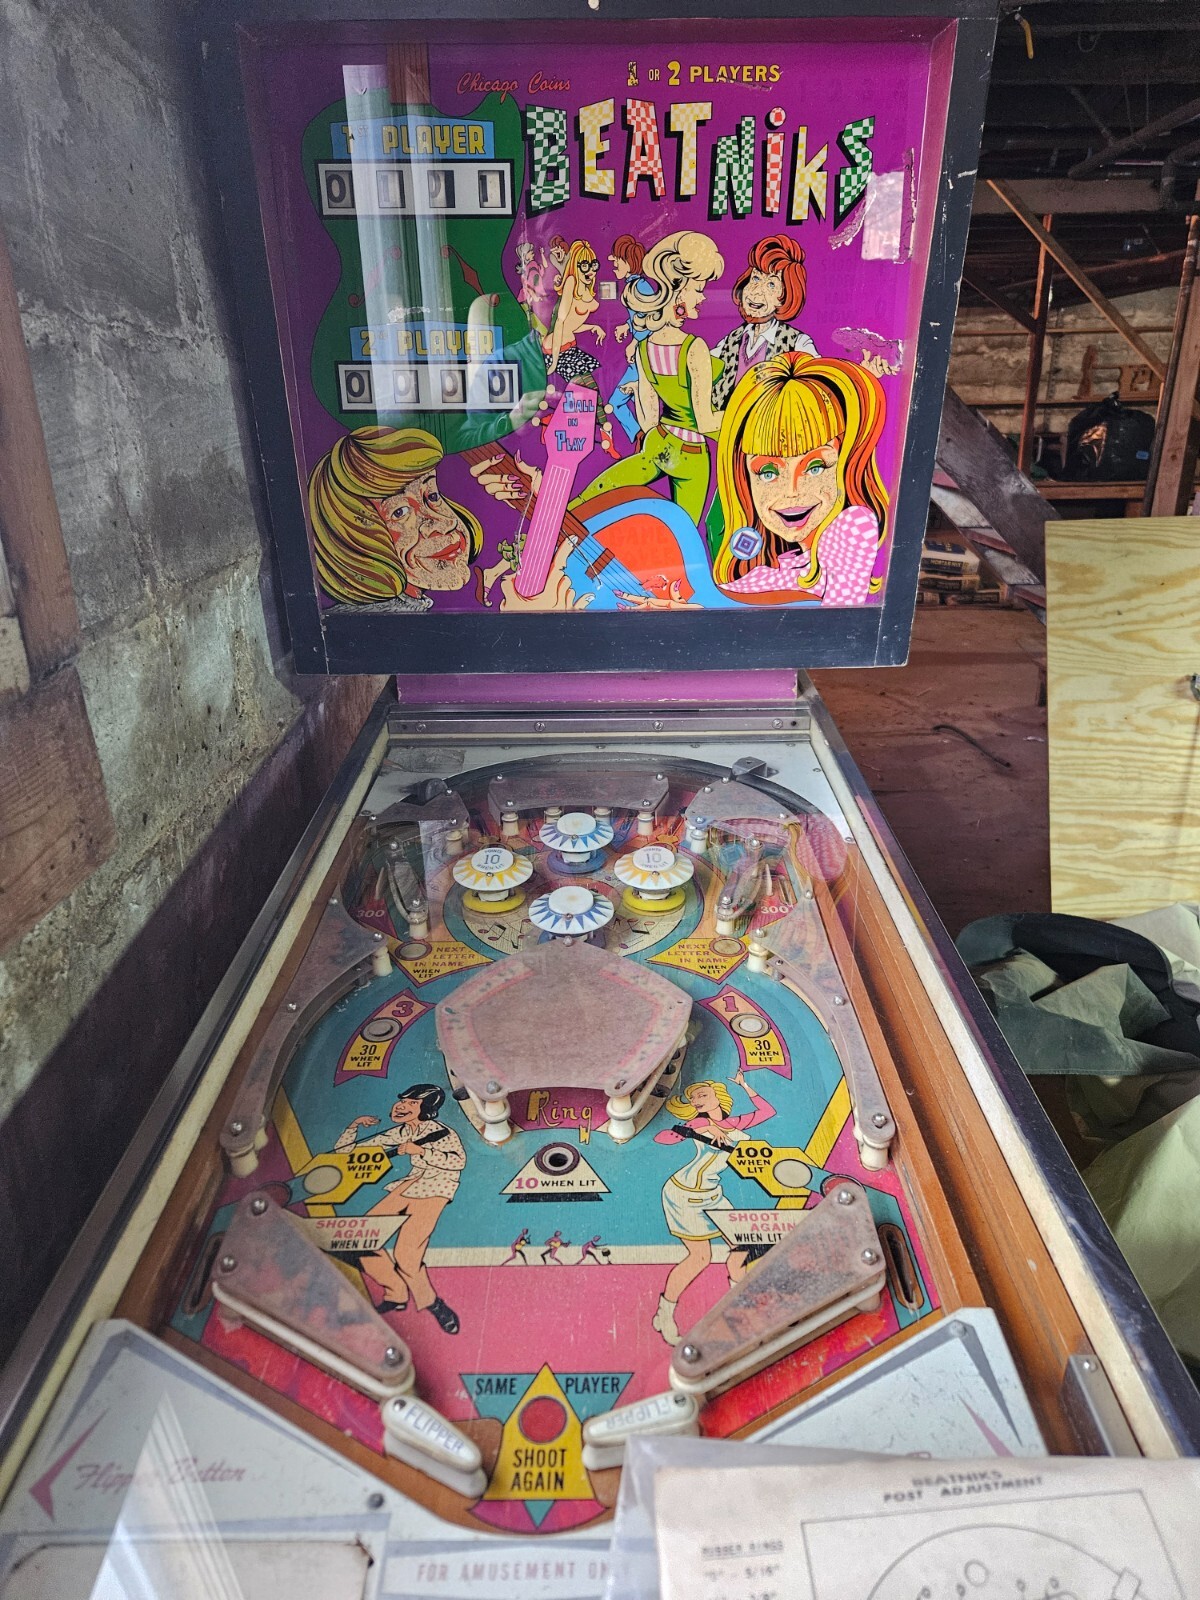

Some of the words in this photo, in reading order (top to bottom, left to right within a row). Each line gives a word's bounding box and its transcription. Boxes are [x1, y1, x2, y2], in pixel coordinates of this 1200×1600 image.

[627, 61, 639, 87] 1
[648, 69, 660, 81] OR
[667, 60, 681, 86] 2
[689, 64, 781, 83] PLAYERS
[456, 72, 519, 104] Chicago
[527, 70, 571, 94] Coins
[382, 125, 485, 154] PLAYER
[397, 330, 494, 356] PLAYER
[563, 391, 595, 413] BALL
[568, 418, 578, 426] IN
[555, 430, 587, 451] PLAY
[484, 854, 500, 864] 10
[646, 853, 662, 863] 10
[356, 910, 385, 918] 300
[761, 905, 789, 914] 300
[392, 1001, 414, 1018] 3
[722, 996, 739, 1012] 1
[360, 1044, 377, 1056] 30
[755, 1040, 771, 1050] 30
[527, 1090, 593, 1145] Ring
[346, 1152, 384, 1164] 100
[735, 1147, 773, 1158] 100
[347, 1164, 382, 1172] WHEN
[747, 1166, 764, 1174] LIT
[354, 1171, 372, 1179] LIT
[515, 1177, 539, 1189] 10
[728, 1213, 779, 1222] SHOOT
[316, 1219, 368, 1229] SHOOT
[751, 1223, 796, 1232] AGAIN
[333, 1229, 381, 1239] AGAIN
[734, 1233, 763, 1242] WHEN
[768, 1233, 782, 1242] LIT
[330, 1240, 359, 1250] WHEN
[363, 1239, 379, 1249] LIT
[476, 1378, 517, 1395] SAME
[565, 1377, 620, 1394] PLAYER
[606, 1395, 672, 1430] FLIPPER
[404, 1403, 465, 1454] FLIPPER
[512, 1449, 567, 1468] SHOOT
[511, 1471, 565, 1491] AGAIN
[912, 1470, 1003, 1487] BEATNIKS
[883, 1490, 922, 1502] POST
[940, 1477, 1043, 1497] ADJUSTMENT
[417, 1563, 449, 1582] FOR
[461, 1561, 576, 1581] AMUSEMENT
